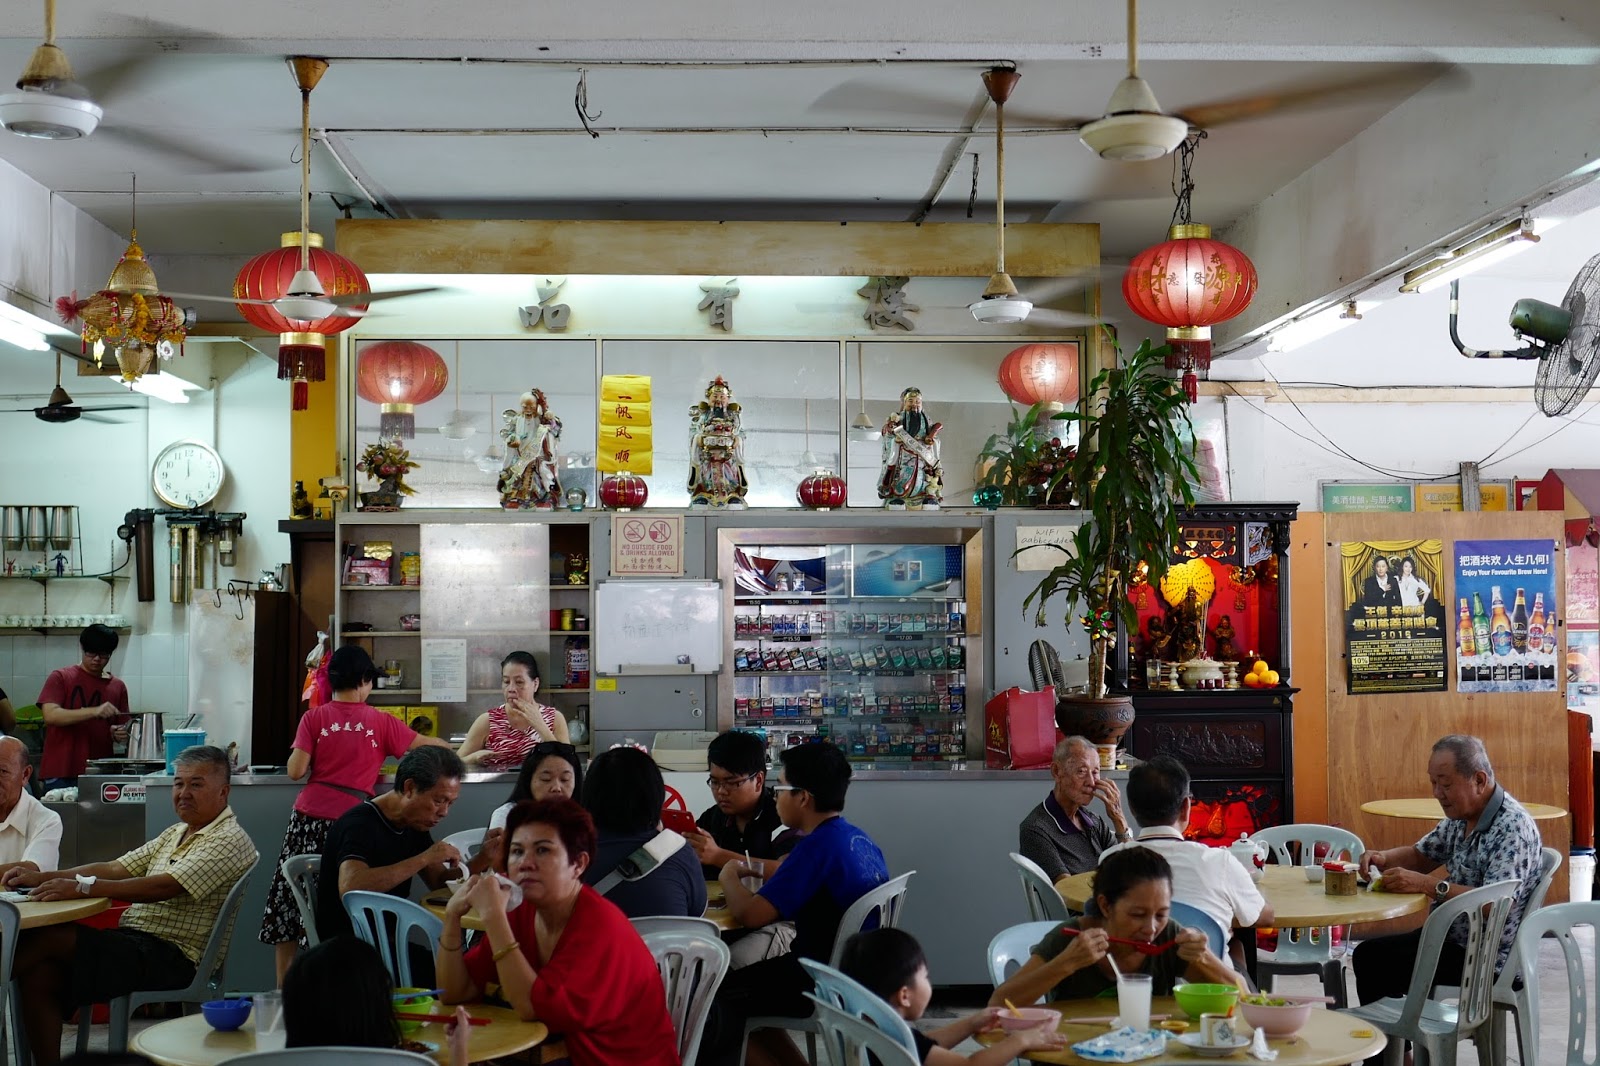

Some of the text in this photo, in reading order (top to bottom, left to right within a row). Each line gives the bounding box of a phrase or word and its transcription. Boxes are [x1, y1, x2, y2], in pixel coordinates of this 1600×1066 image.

[1459, 555, 1501, 566] 把酒共欢
[1462, 569, 1477, 577] Enjoy
[1491, 568, 1517, 576] Favourite
